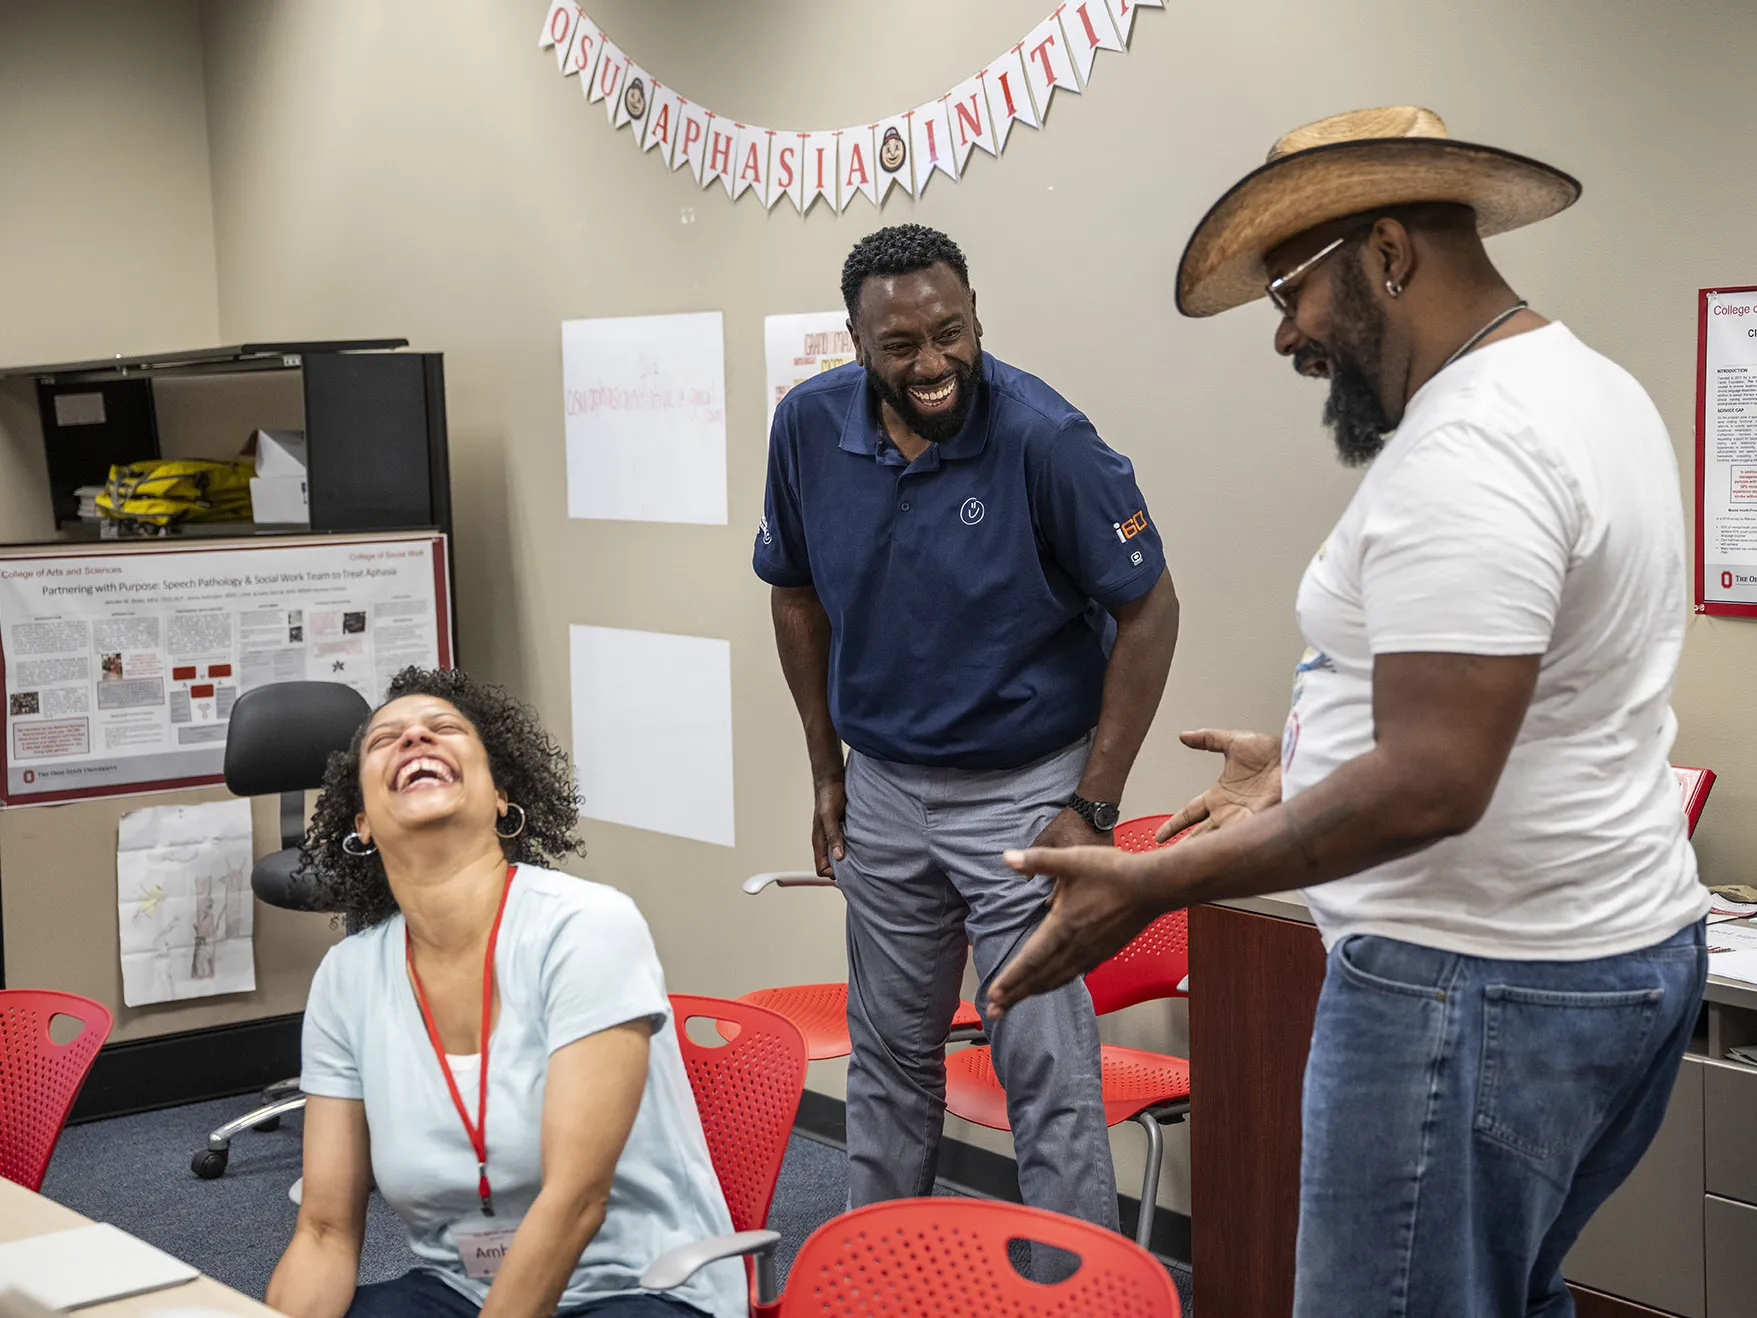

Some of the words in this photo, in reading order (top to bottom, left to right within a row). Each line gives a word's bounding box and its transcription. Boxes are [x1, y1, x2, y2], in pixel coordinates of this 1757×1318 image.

[551, 6, 621, 97] OSU
[651, 103, 869, 188] APHASIA
[1713, 305, 1750, 316] College
[1, 569, 34, 580] College
[36, 568, 45, 578] of
[46, 567, 64, 577] Arts
[66, 566, 82, 577] and
[84, 566, 123, 576] Sciences
[42, 584, 93, 597] Partnering
[95, 583, 117, 594] with
[119, 581, 160, 593] Purpose:
[163, 579, 196, 591] Speech
[198, 576, 242, 589] Pathology
[244, 574, 252, 585] &
[254, 573, 279, 585] Social
[280, 571, 304, 583] Work
[306, 570, 331, 581] Team
[332, 570, 341, 580] to
[342, 567, 364, 578] Treat
[366, 567, 397, 578] Aphasia
